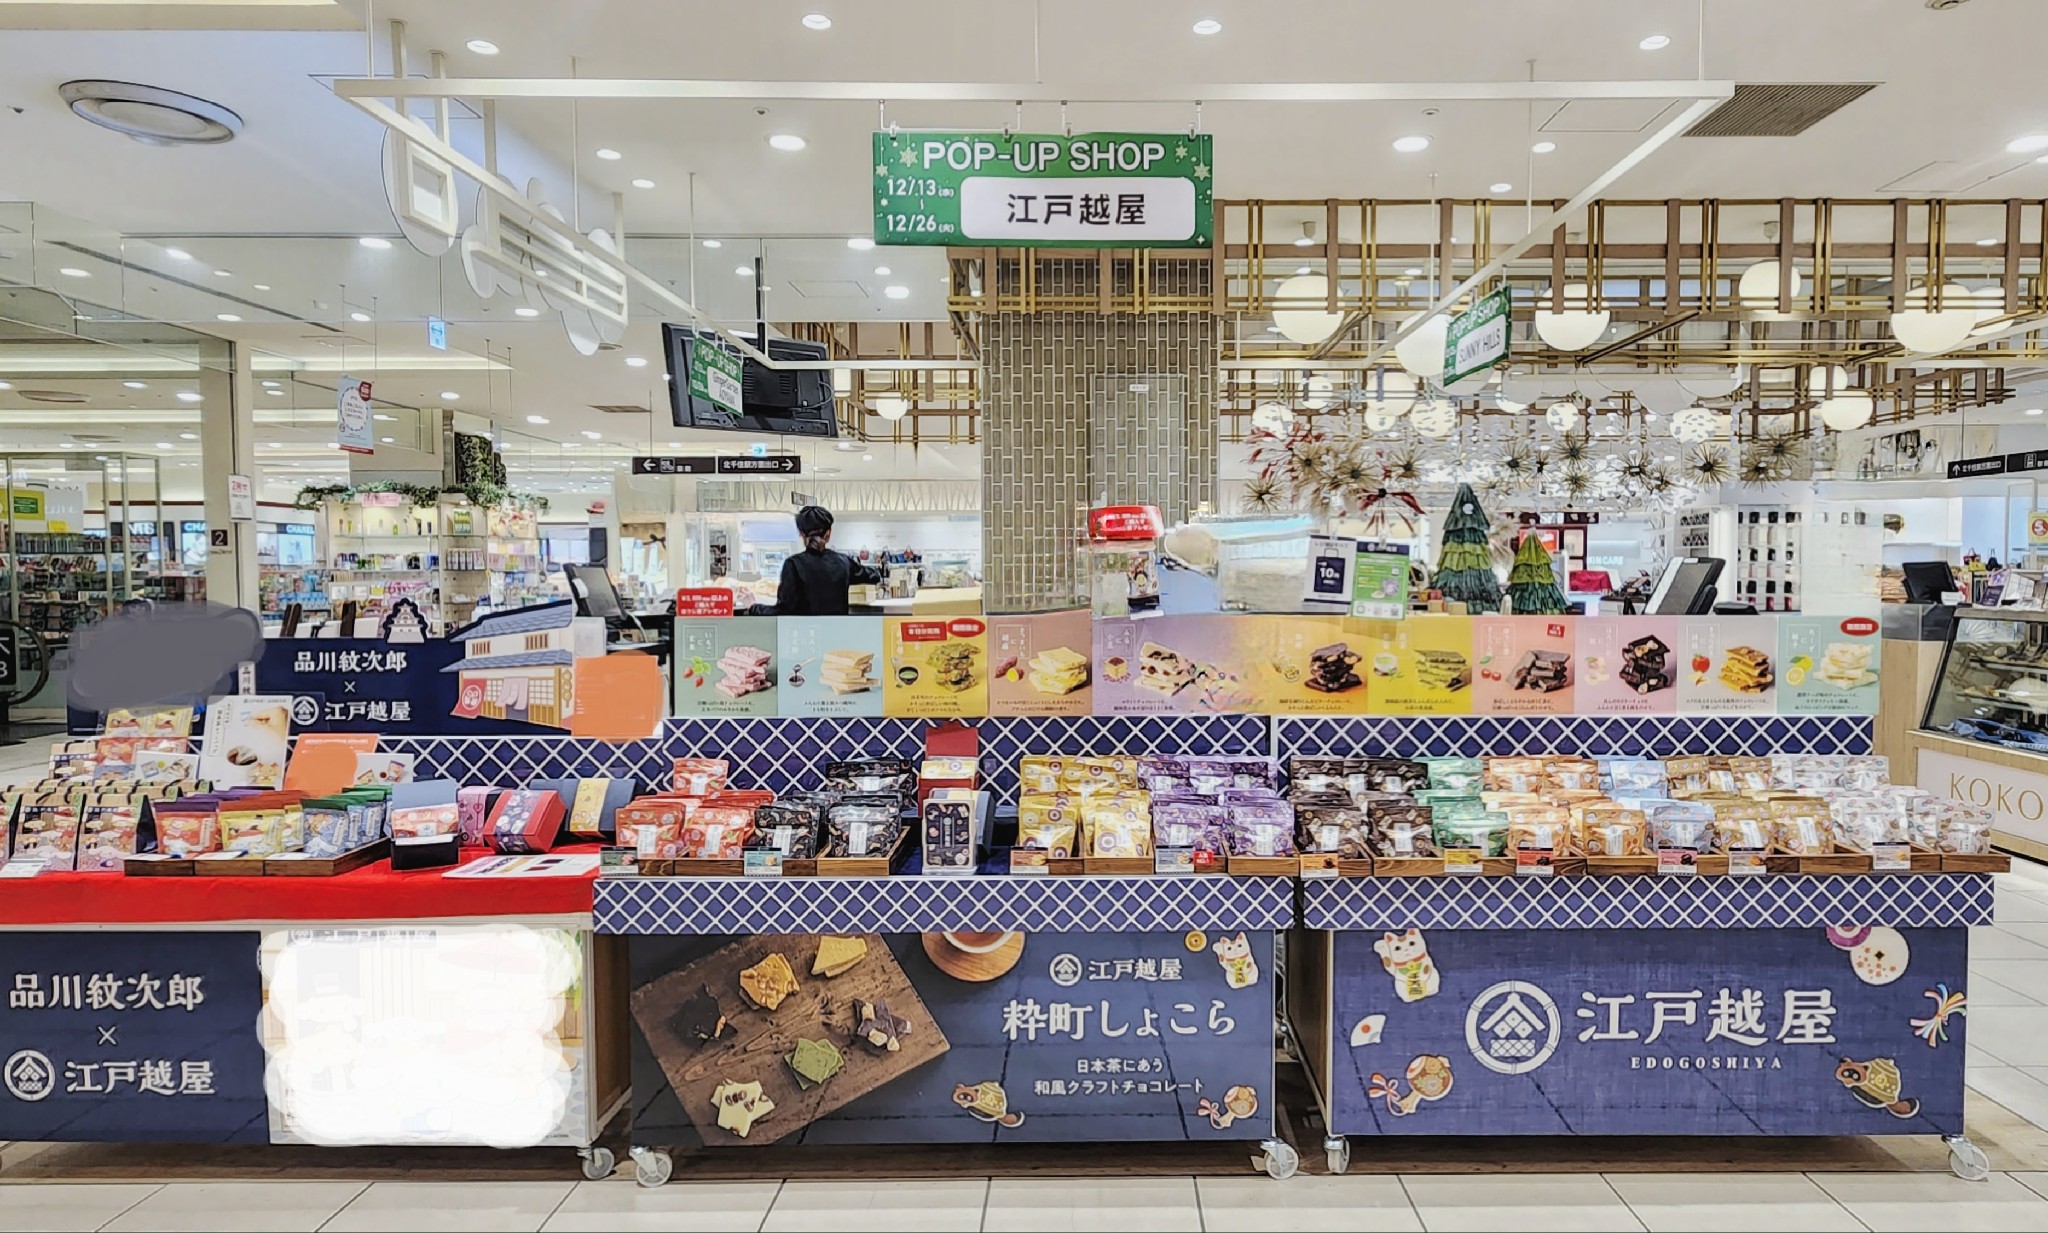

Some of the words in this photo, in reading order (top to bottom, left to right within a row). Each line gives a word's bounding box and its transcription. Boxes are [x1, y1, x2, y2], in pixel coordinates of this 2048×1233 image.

[922, 140, 1060, 172] POP-UP
[1069, 140, 1166, 172] SHOP
[1006, 193, 1147, 226] 江戸越屋
[214, 530, 225, 546] 2
[293, 651, 408, 673] 品川紋次郎
[324, 701, 411, 722] 江戸越屋
[1950, 772, 2045, 821] KOKO
[1087, 957, 1184, 982] 江戸越屋
[9, 972, 205, 1012] 品川紋次郎
[1001, 997, 1236, 1042] 粋町しょこら
[1575, 986, 1839, 1047] 江戸越屋
[1076, 1057, 1164, 1074] 日本茶にあう
[1630, 1056, 1783, 1069] EDOGOSHIYA
[64, 1059, 217, 1096] 江戸越屋
[1034, 1078, 1205, 1096] 和風クラフトチョコレート
